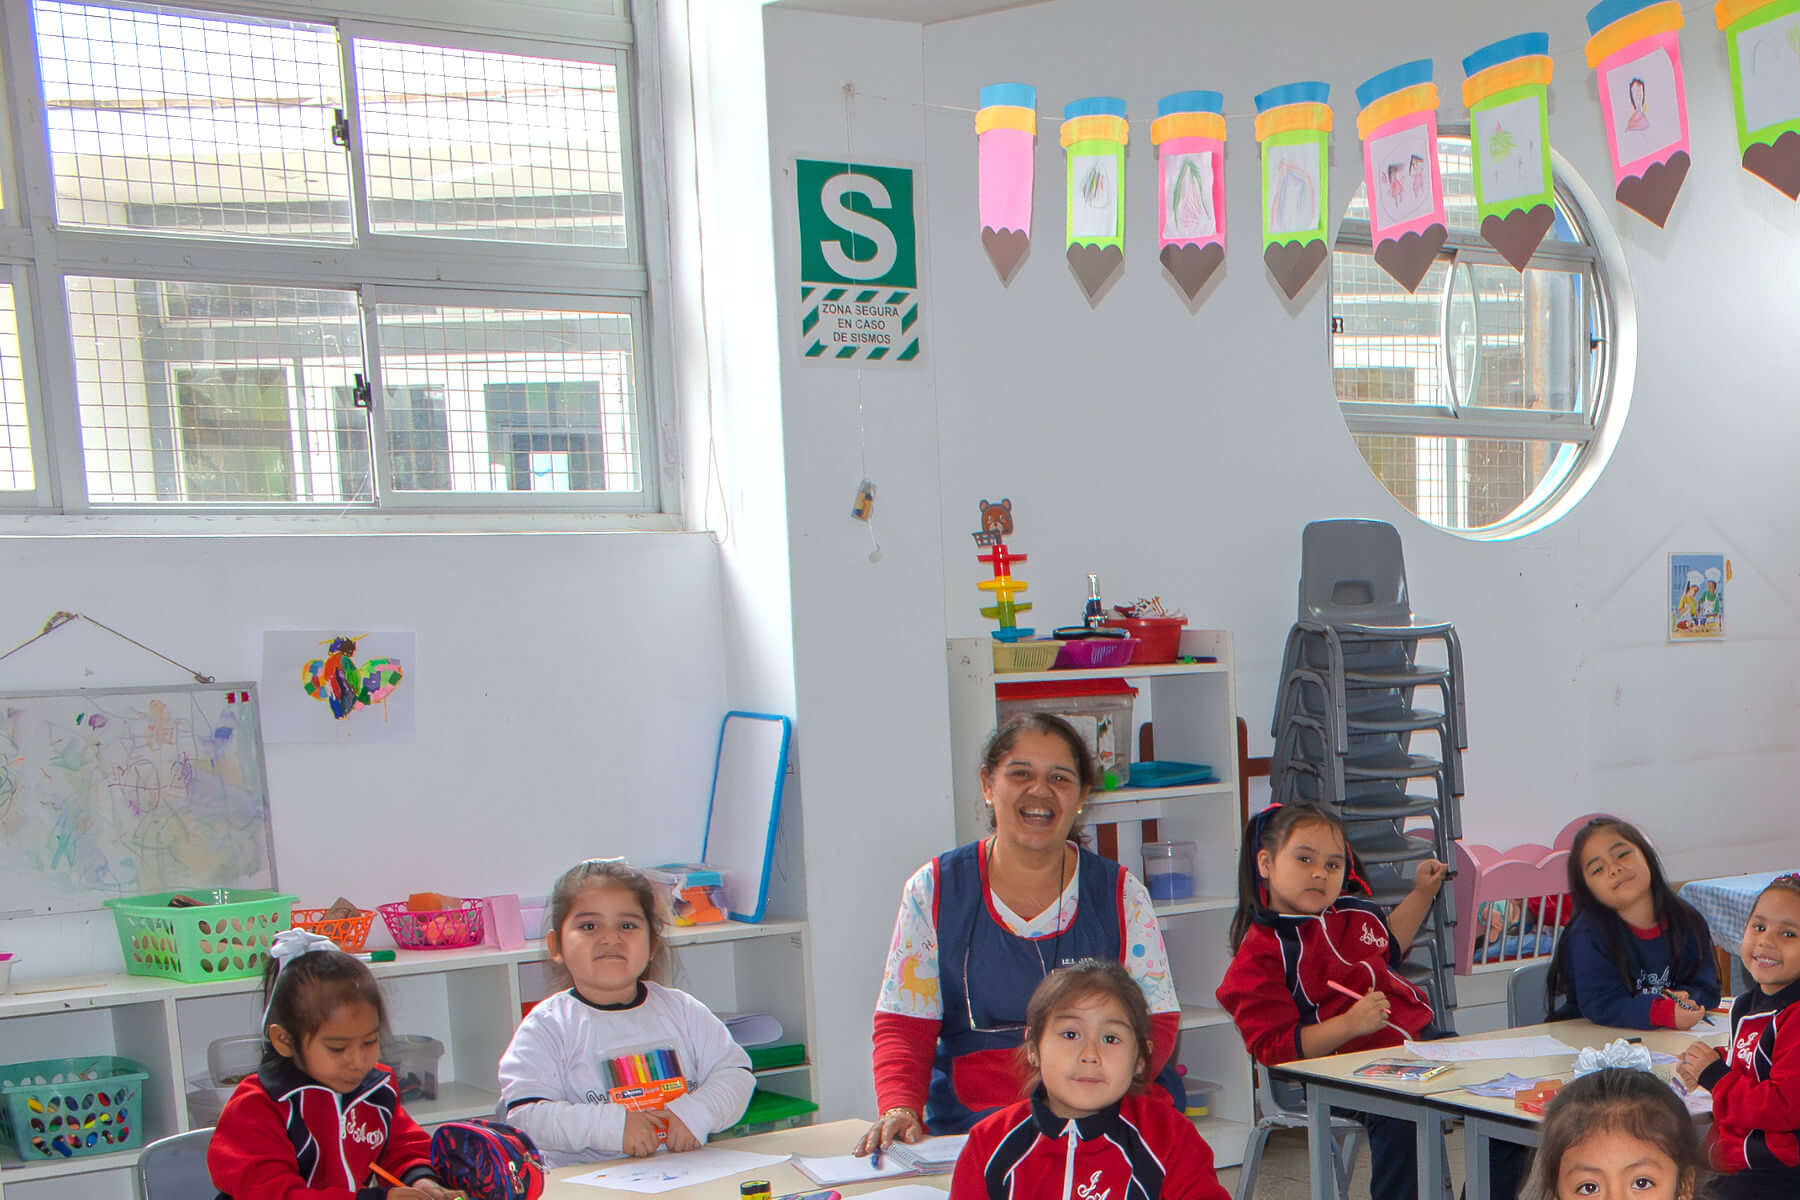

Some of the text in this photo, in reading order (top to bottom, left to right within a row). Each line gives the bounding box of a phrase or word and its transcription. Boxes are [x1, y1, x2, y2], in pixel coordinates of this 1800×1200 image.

[820, 173, 898, 281] S
[822, 303, 899, 317] ZONA SEGURA
[838, 318, 886, 330] EN CASO
[833, 331, 891, 344] DE SISMOS
